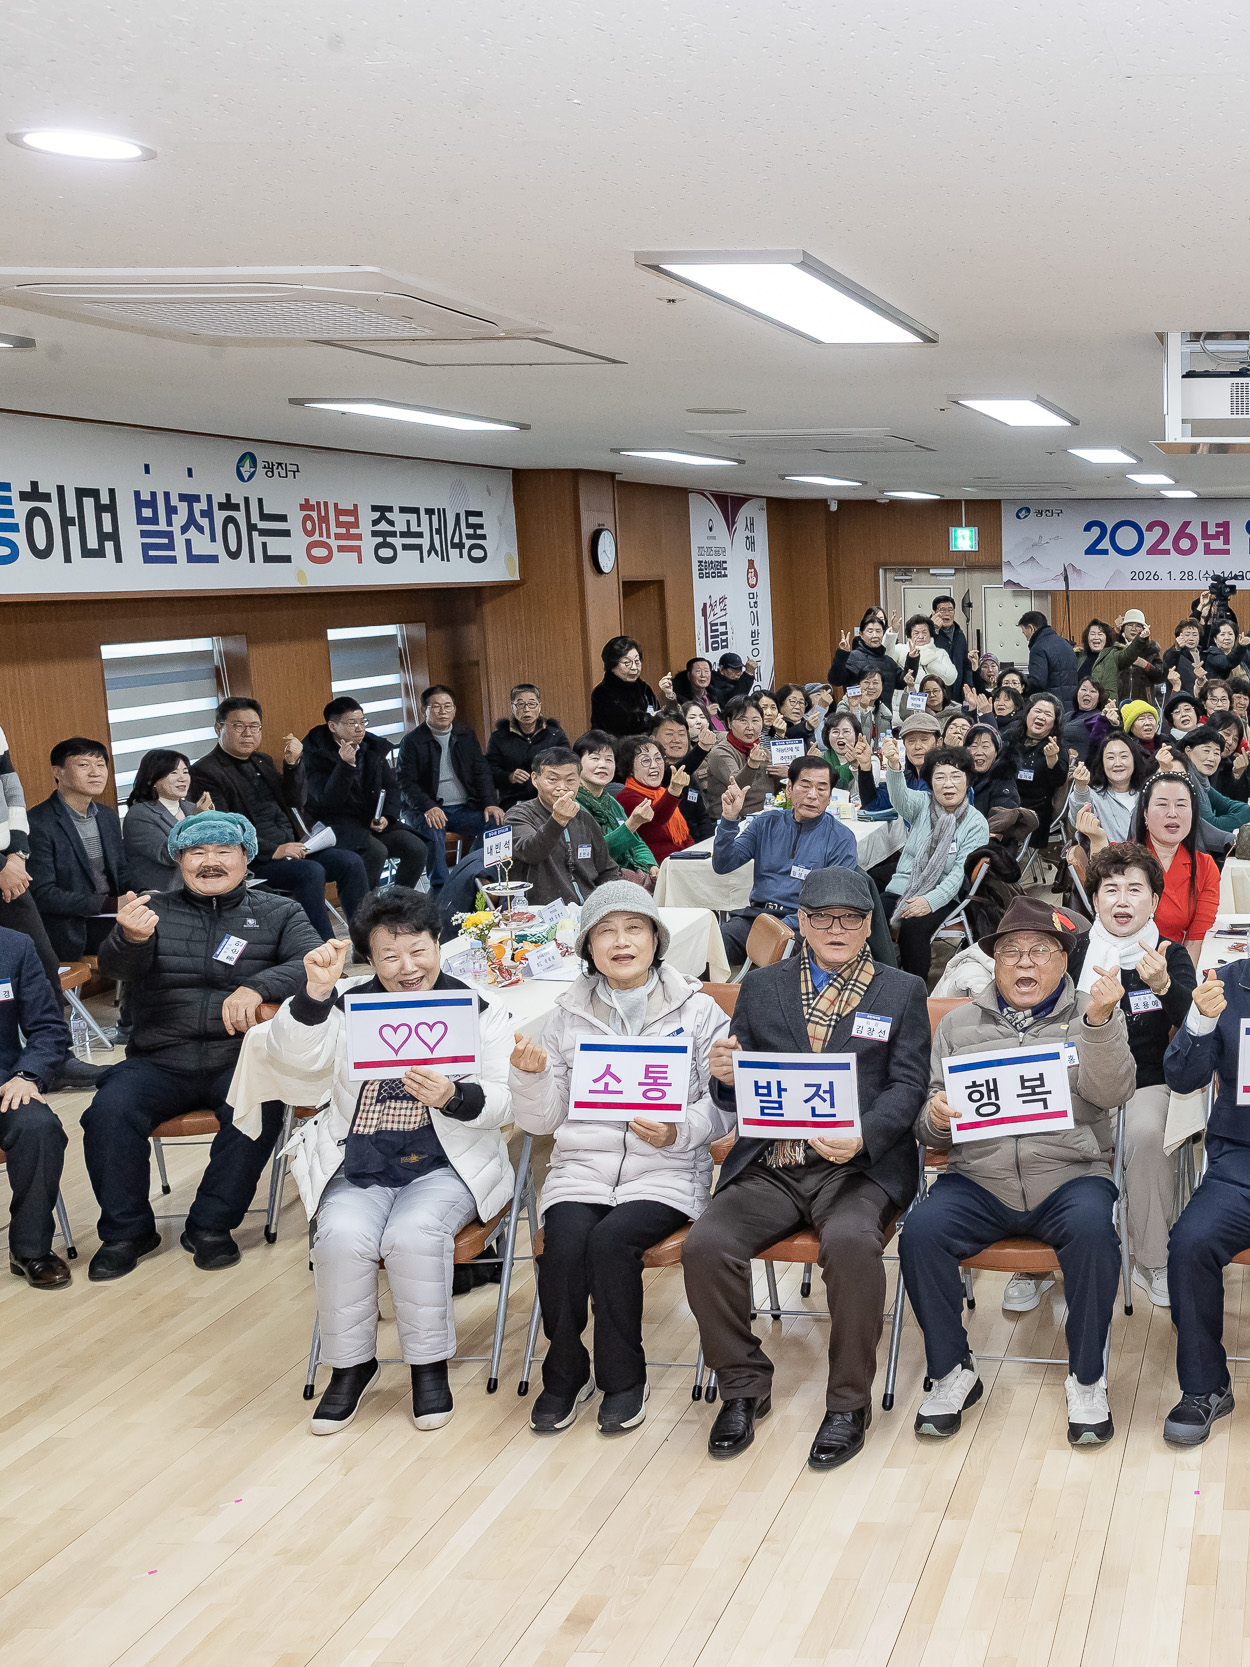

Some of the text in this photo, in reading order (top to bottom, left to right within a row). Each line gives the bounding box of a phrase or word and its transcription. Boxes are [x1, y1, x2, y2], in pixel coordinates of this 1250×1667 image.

[261, 460, 300, 480] 광진구
[133, 489, 292, 565] 발전하는
[299, 497, 363, 565] 행복
[370, 504, 488, 564] 중곡제4동
[1034, 508, 1064, 518] 광진구
[744, 516, 756, 552] 새해
[1083, 519, 1230, 556] 2026년
[1130, 570, 1163, 581] 2026.
[1167, 570, 1177, 581] 1.
[487, 839, 511, 856] 내빈석
[588, 1063, 673, 1101] 소통
[753, 1079, 838, 1119] 발전
[964, 1072, 1053, 1118] 행복
